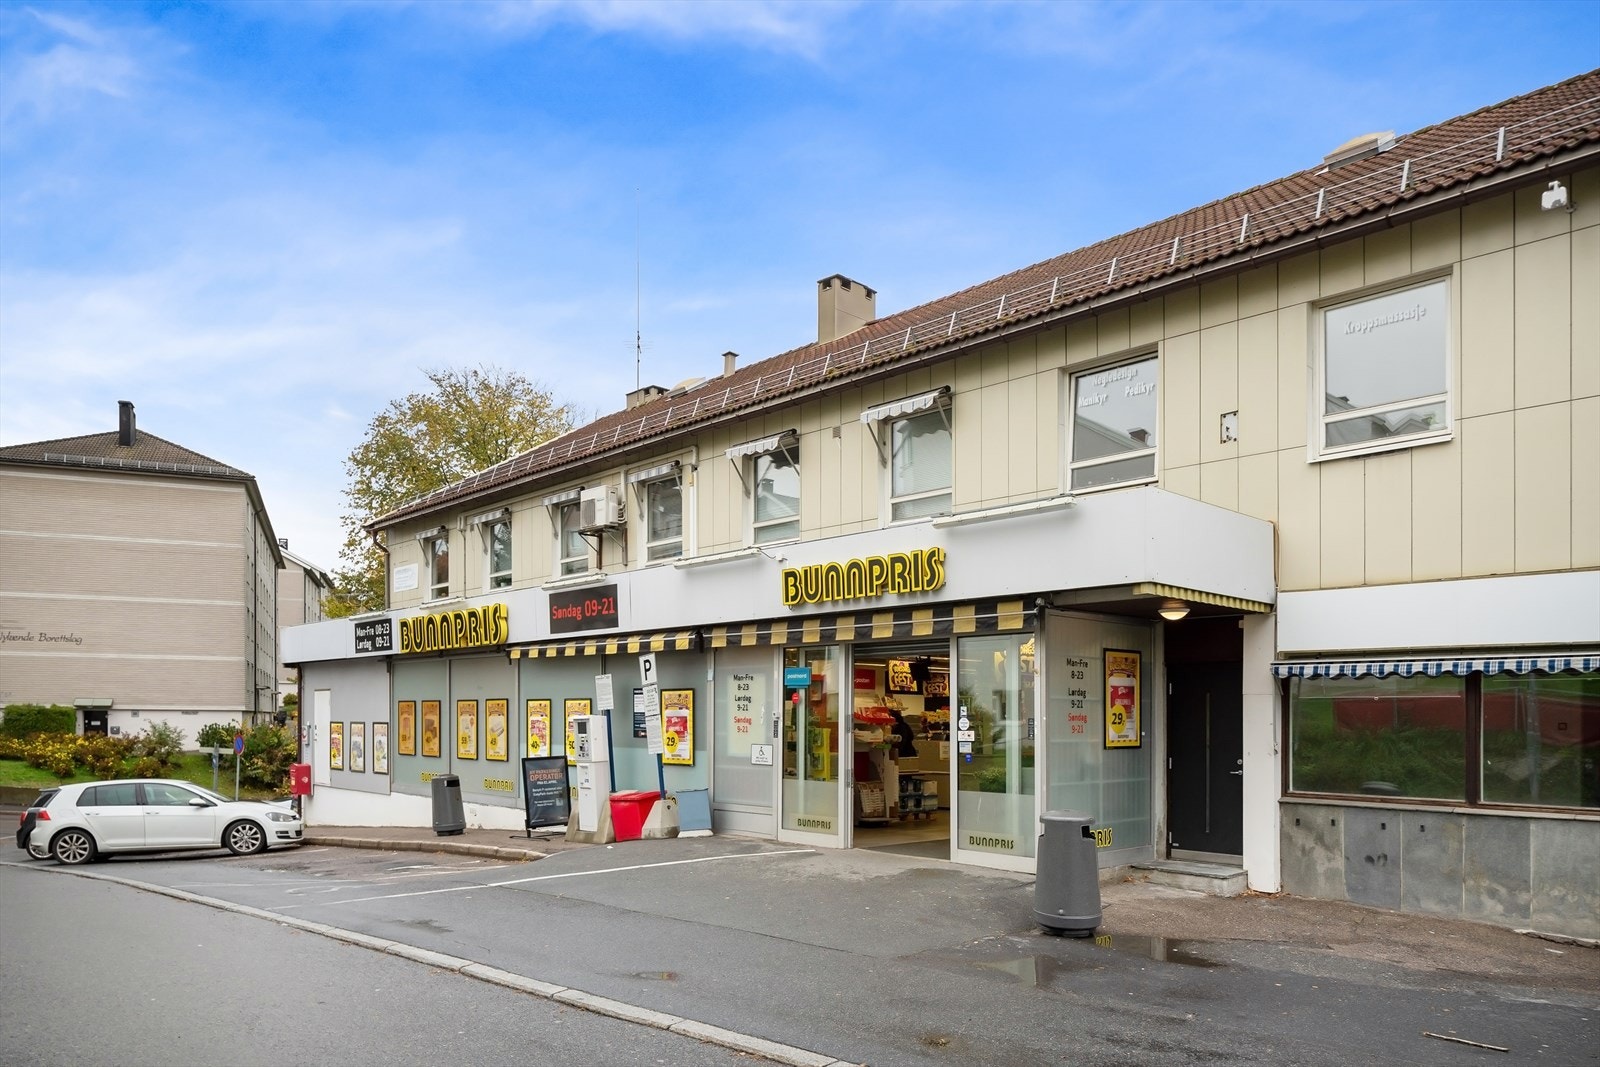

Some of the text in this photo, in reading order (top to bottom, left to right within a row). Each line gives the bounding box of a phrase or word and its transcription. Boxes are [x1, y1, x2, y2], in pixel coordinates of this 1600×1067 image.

[1344, 304, 1426, 335] Kroppsmassasje
[1078, 382, 1156, 407] Manikyr Pedikyr
[782, 547, 946, 606] BUNNPRIS
[552, 597, 615, 620] Søndag 09-21
[375, 623, 390, 635] 08-23
[399, 602, 509, 654] BUNNPRIS
[38, 632, 83, 645] Borettslag
[356, 636, 390, 651] Lørdag 09-21
[1066, 658, 1088, 668] Man-Fre
[643, 659, 652, 681] P
[1071, 670, 1084, 680] 8-23
[734, 694, 752, 703] Lørdag
[1068, 687, 1086, 699] Lørdag
[1071, 700, 1083, 708] 9-21
[733, 716, 752, 725] Søndag
[1068, 712, 1087, 723] Søndag
[1071, 724, 1084, 733] 9-21
[529, 773, 563, 782] OPERATOR
[797, 818, 831, 830] BUNNPRIS
[969, 835, 1014, 850] BUNNPRIS
